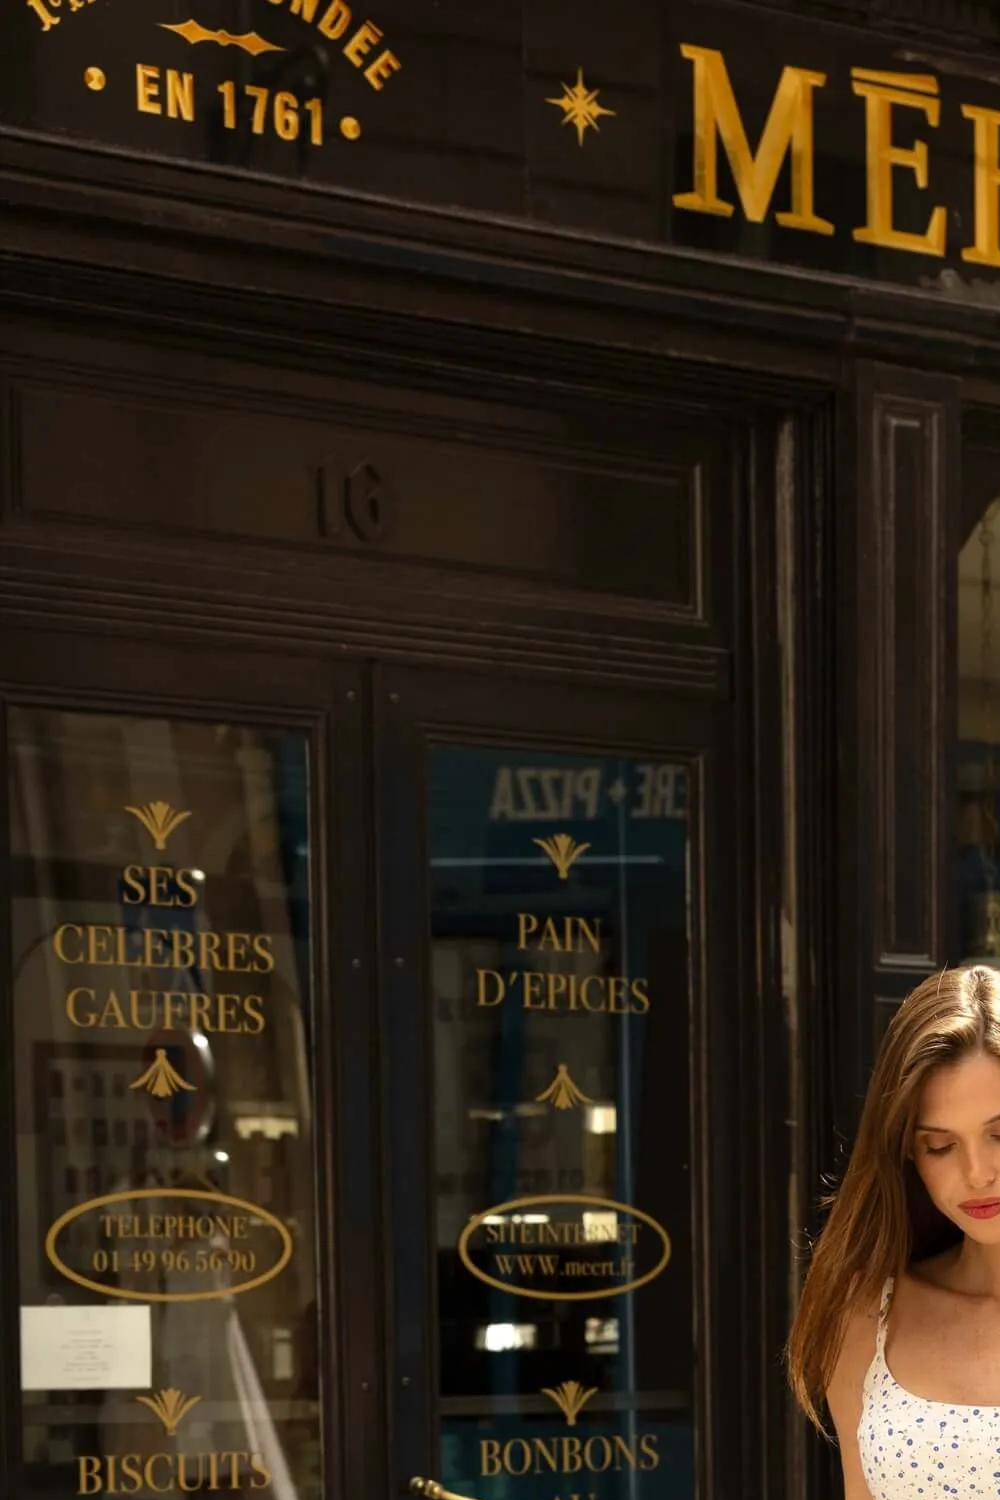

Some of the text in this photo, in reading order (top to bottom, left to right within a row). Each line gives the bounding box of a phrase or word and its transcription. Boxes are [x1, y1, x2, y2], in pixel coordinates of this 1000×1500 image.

[267, 0, 401, 91] NDÉE
[136, 63, 323, 146] EN 1761
[308, 451, 385, 543] 16
[122, 865, 198, 907] SES
[53, 923, 275, 974] CELEBRES
[516, 913, 601, 953] PAIN
[66, 986, 266, 1034] GAUFRES
[476, 968, 650, 1015] D'EPICES
[101, 1215, 249, 1239] TELEPHONE
[486, 1223, 535, 1244] SITE
[93, 1250, 256, 1272] 01 49 96 56 90
[77, 1452, 271, 1494] BISCUITS
[480, 1434, 659, 1476] BONBONS
